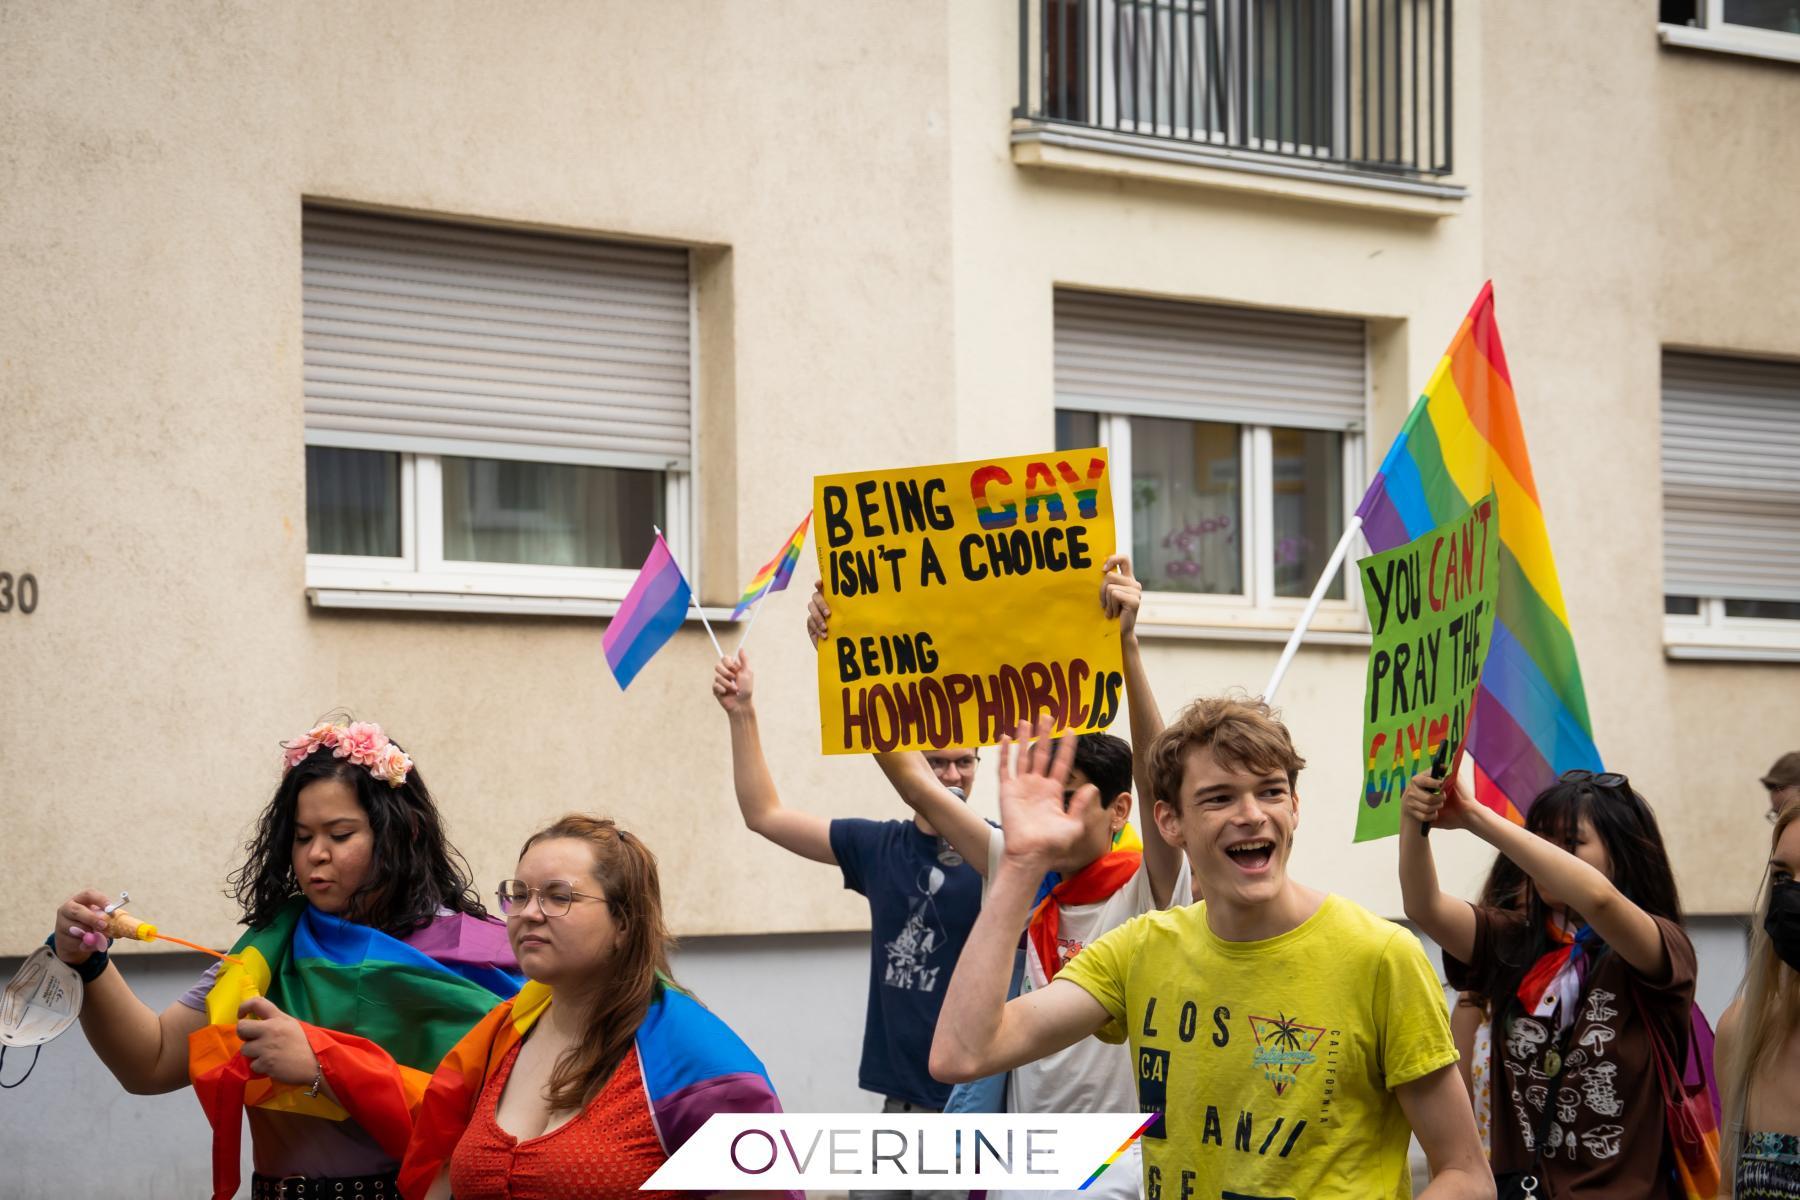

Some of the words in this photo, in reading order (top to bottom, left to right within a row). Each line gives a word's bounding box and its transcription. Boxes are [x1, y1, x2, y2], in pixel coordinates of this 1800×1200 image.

[823, 478, 954, 548] BEING
[970, 457, 1105, 531] GAY
[829, 544, 907, 598] ISN'T
[920, 537, 947, 587] A
[959, 525, 1092, 582] CHOICE
[1366, 550, 1421, 636] YOU
[1428, 500, 1492, 612] CAN'T
[836, 631, 939, 683] BEING
[1370, 627, 1441, 723] PRAY
[1449, 600, 1484, 697] THE
[842, 658, 1090, 753] HOMOPHOBIC
[1087, 671, 1123, 729] IS
[1365, 716, 1425, 809] GAY
[1140, 1053, 1164, 1083] CA
[1143, 997, 1231, 1048] LOS
[1319, 1030, 1341, 1124] CALIFORNIA
